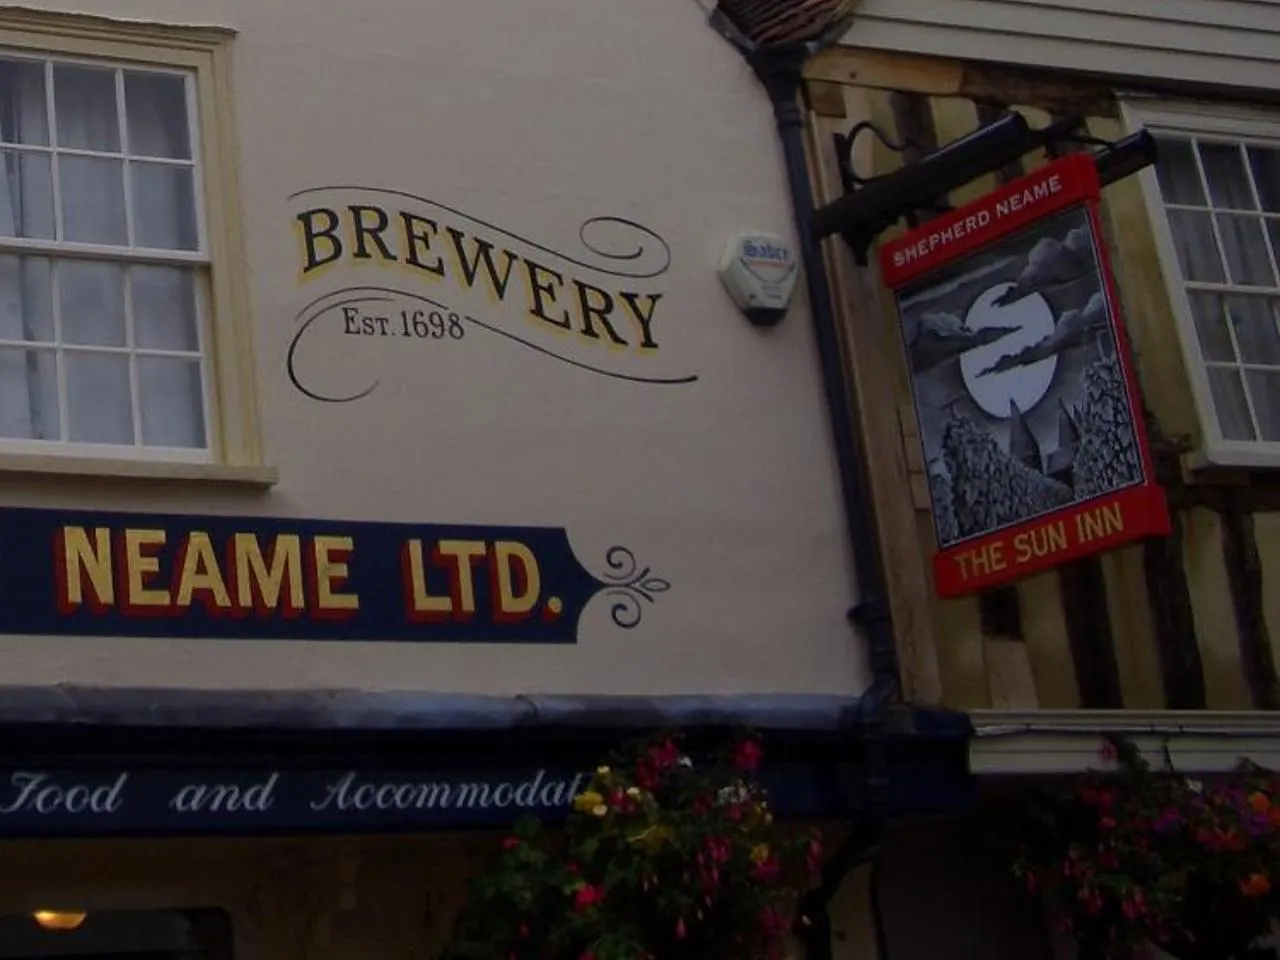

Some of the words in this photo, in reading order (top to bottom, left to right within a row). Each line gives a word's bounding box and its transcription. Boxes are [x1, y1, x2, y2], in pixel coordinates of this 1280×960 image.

[892, 208, 991, 268] SHEPHERD
[995, 174, 1064, 217] NEAME
[296, 204, 663, 349] BREWERY
[54, 525, 360, 621] NEAME
[400, 537, 564, 626] LTD.
[953, 542, 1007, 581] THE
[1015, 520, 1068, 564] SUN
[1076, 500, 1124, 542] INN
[170, 772, 280, 812] and
